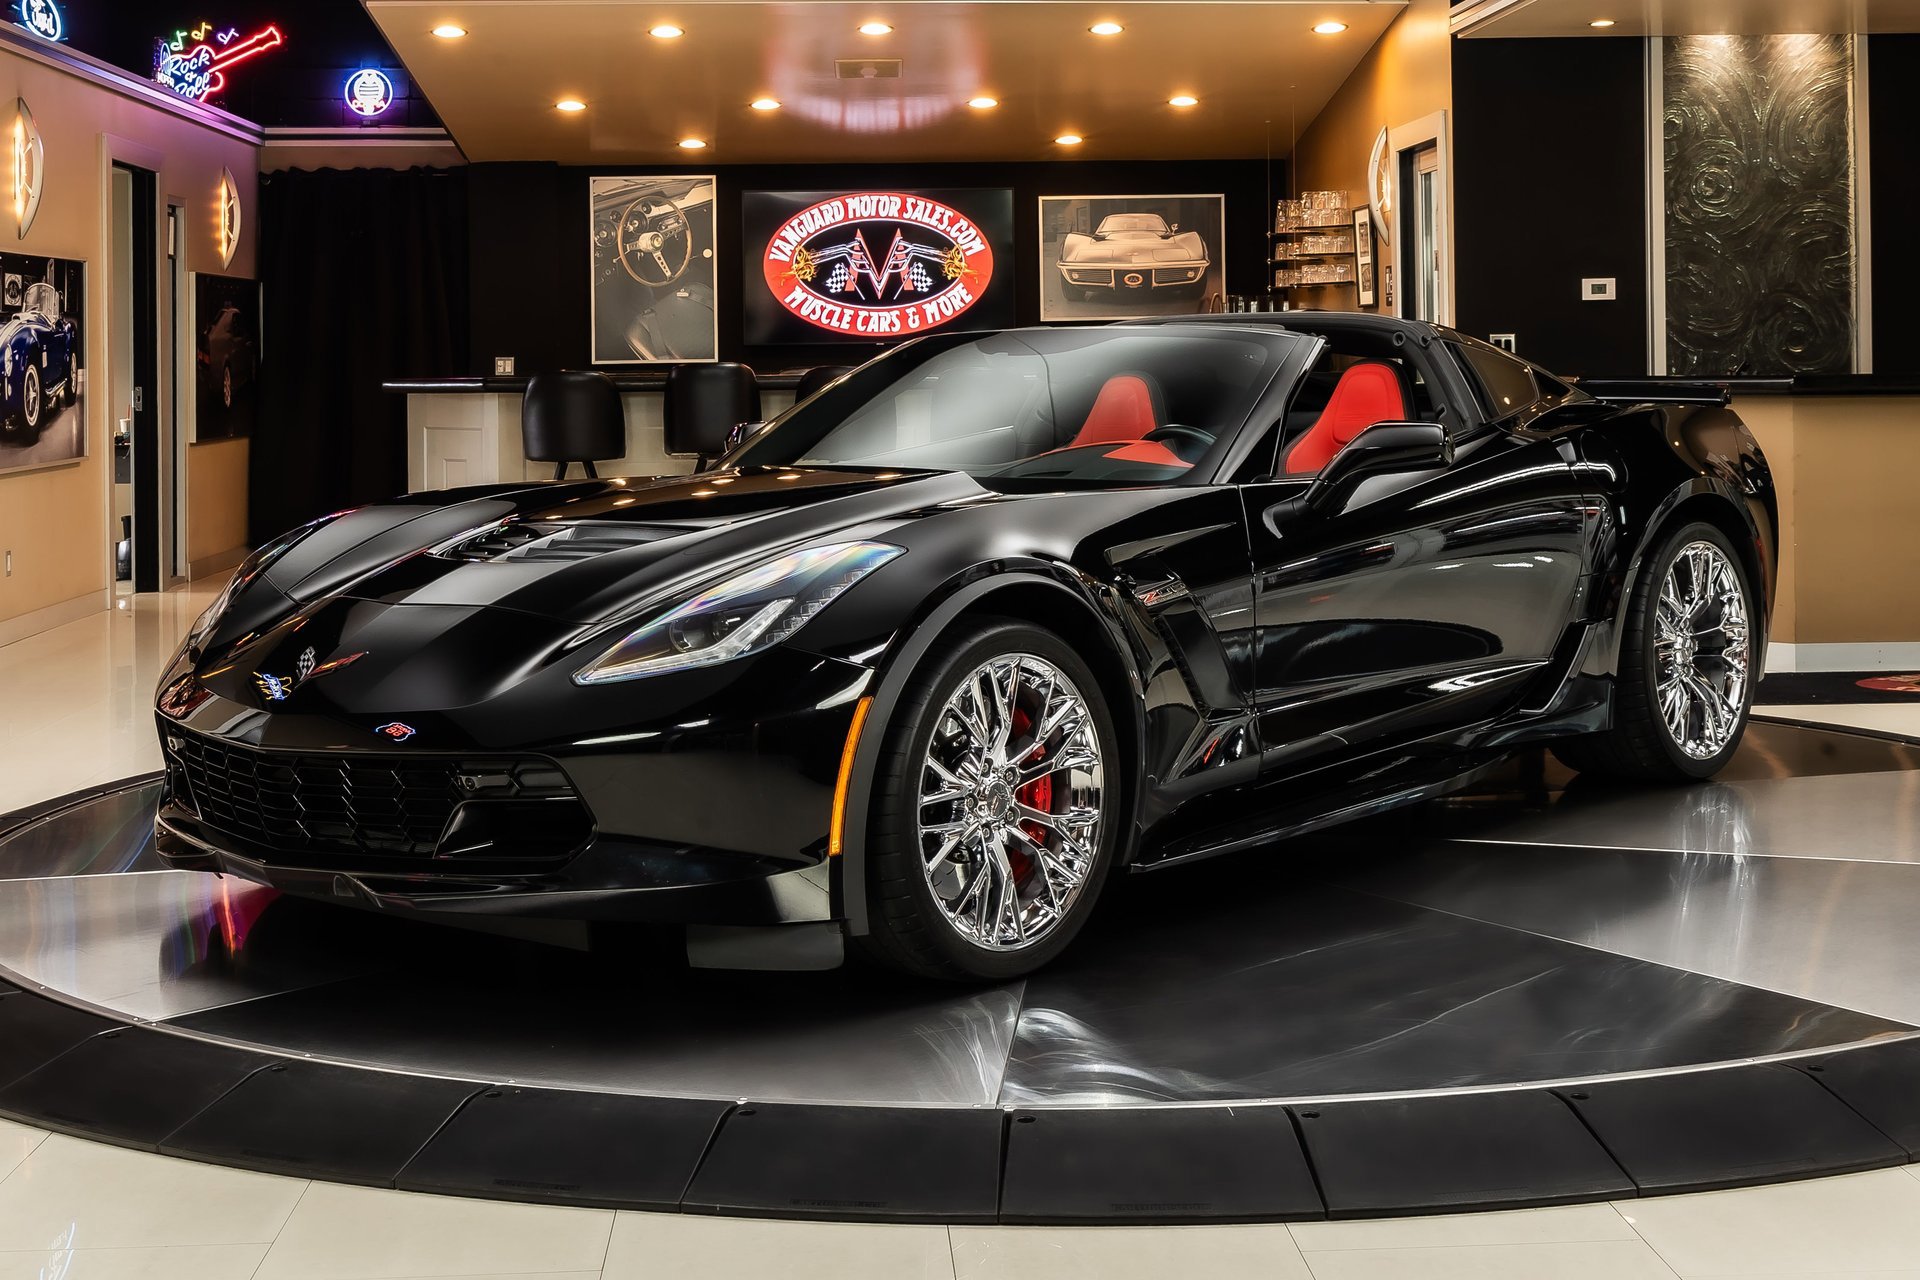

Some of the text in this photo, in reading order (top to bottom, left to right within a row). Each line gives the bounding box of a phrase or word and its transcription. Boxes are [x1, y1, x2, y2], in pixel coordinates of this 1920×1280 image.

[170, 48, 210, 76] Rock
[768, 195, 986, 263] VANGUARD MOTOR SALES.COM
[784, 285, 973, 333] MUSCLE CARS & MORE
